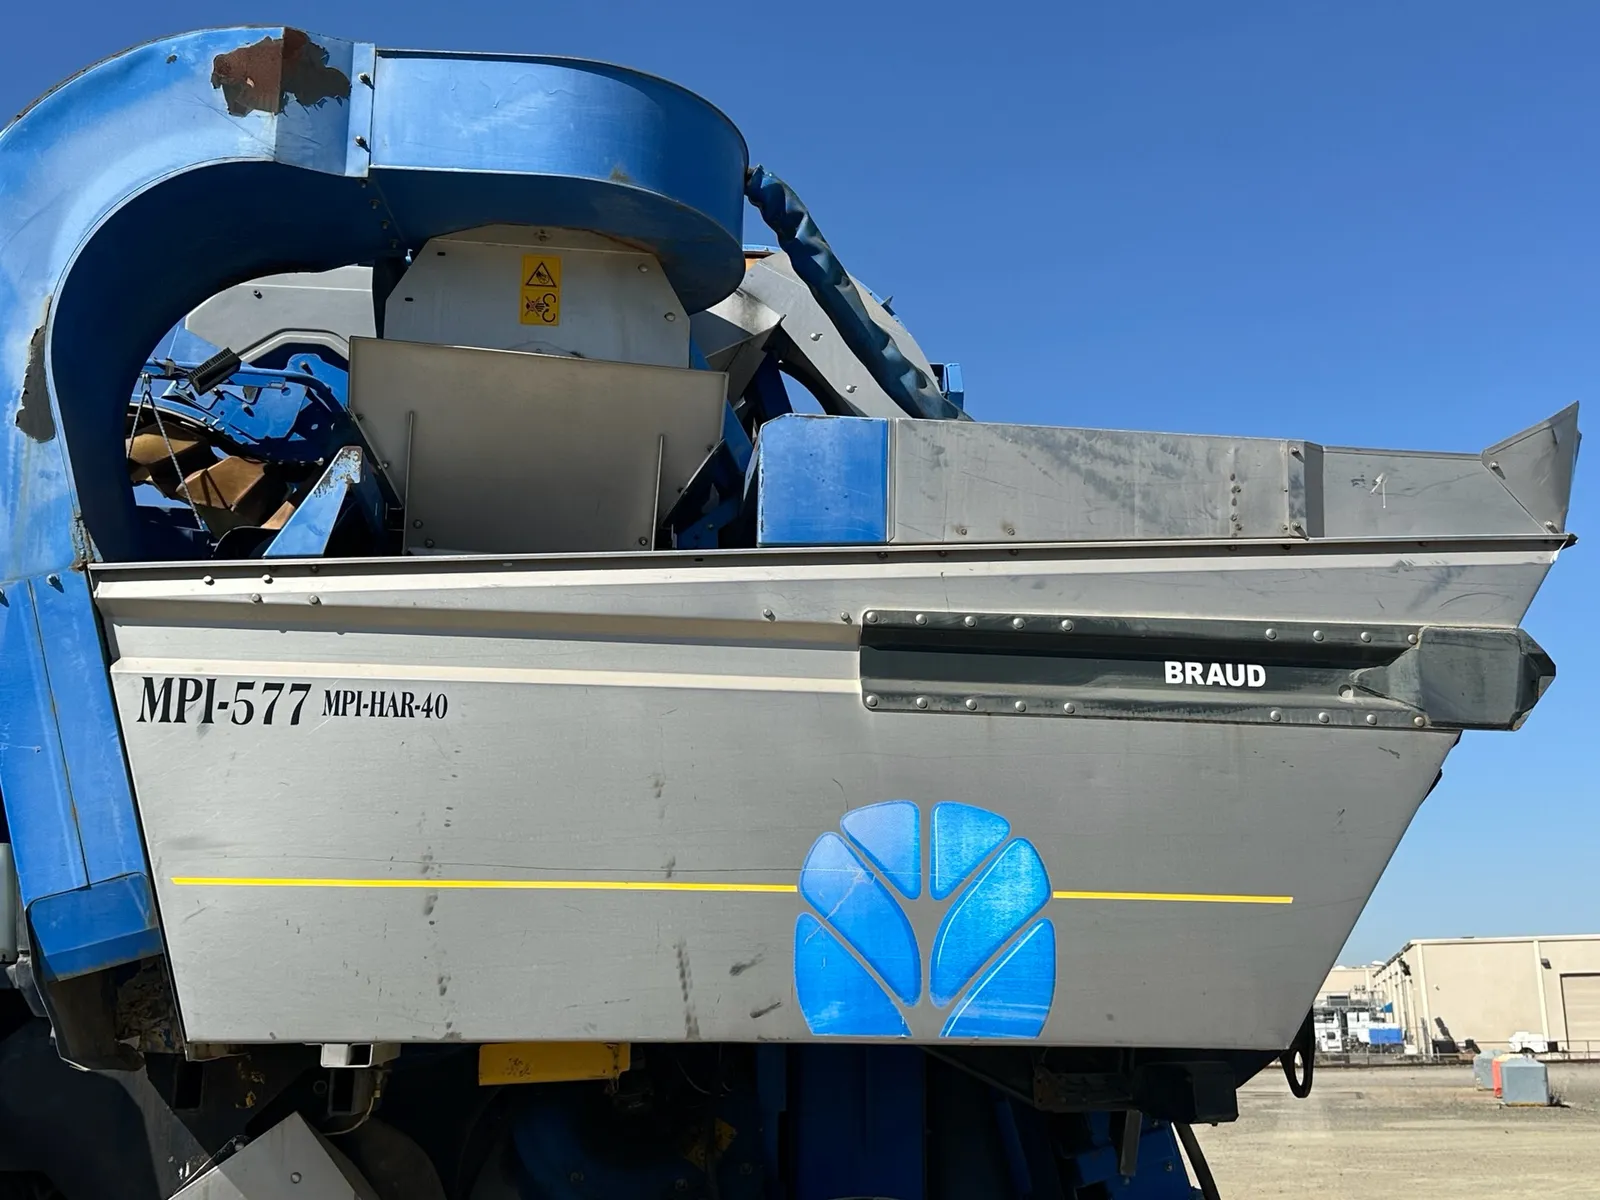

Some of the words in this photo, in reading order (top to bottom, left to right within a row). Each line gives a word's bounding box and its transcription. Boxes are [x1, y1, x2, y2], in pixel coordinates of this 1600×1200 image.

[1164, 661, 1266, 687] BRAUD
[136, 676, 312, 725] MPI-577
[322, 689, 448, 719] MPI-HAR-40
